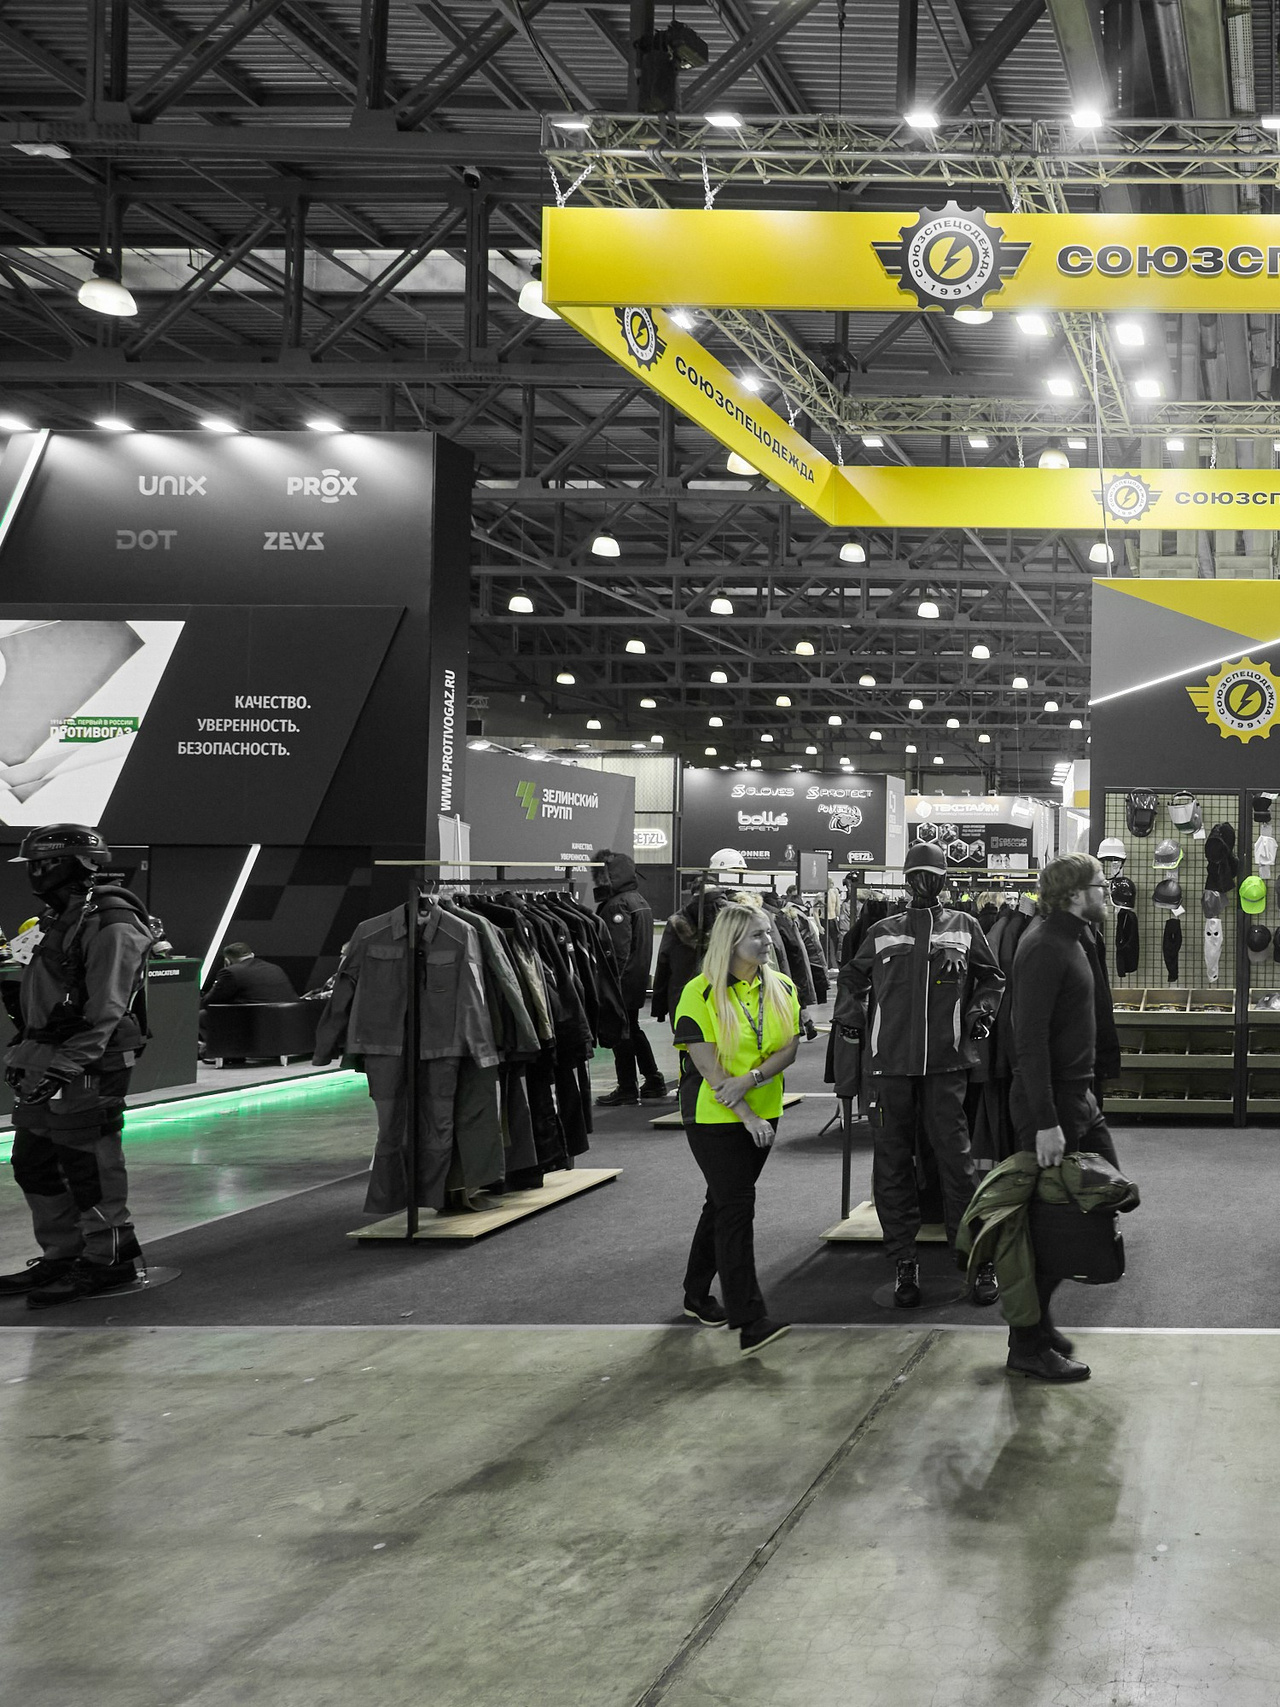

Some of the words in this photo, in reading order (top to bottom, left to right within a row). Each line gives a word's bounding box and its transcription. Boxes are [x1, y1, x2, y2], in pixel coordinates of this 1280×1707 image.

[911, 219, 990, 279] СОЮЗСПЕЦОДЕЖДА
[930, 284, 973, 296] 1991
[675, 356, 815, 484] СОЮЗСПЕЦОДЕЖДА
[138, 475, 207, 496] UNIX
[287, 472, 358, 499] PROX
[116, 529, 178, 550] DOT
[1216, 670, 1274, 716] СОЮЗСПЕЦОДЕЖДА
[235, 695, 311, 710] КАЧЕСТВО.
[197, 718, 300, 733] УВЕРЕННОСТЬ.
[1230, 719, 1261, 729] 1991
[177, 741, 290, 756] БЕЗОПАСНОСТЬ.
[441, 669, 456, 812] WWW.PROTIVOGAZ.RU
[542, 788, 598, 809] ЗЕЛИНСКИЙ
[541, 804, 573, 820] ГРУПП
[634, 833, 667, 845] ETZL
[738, 850, 771, 858] ONNER
